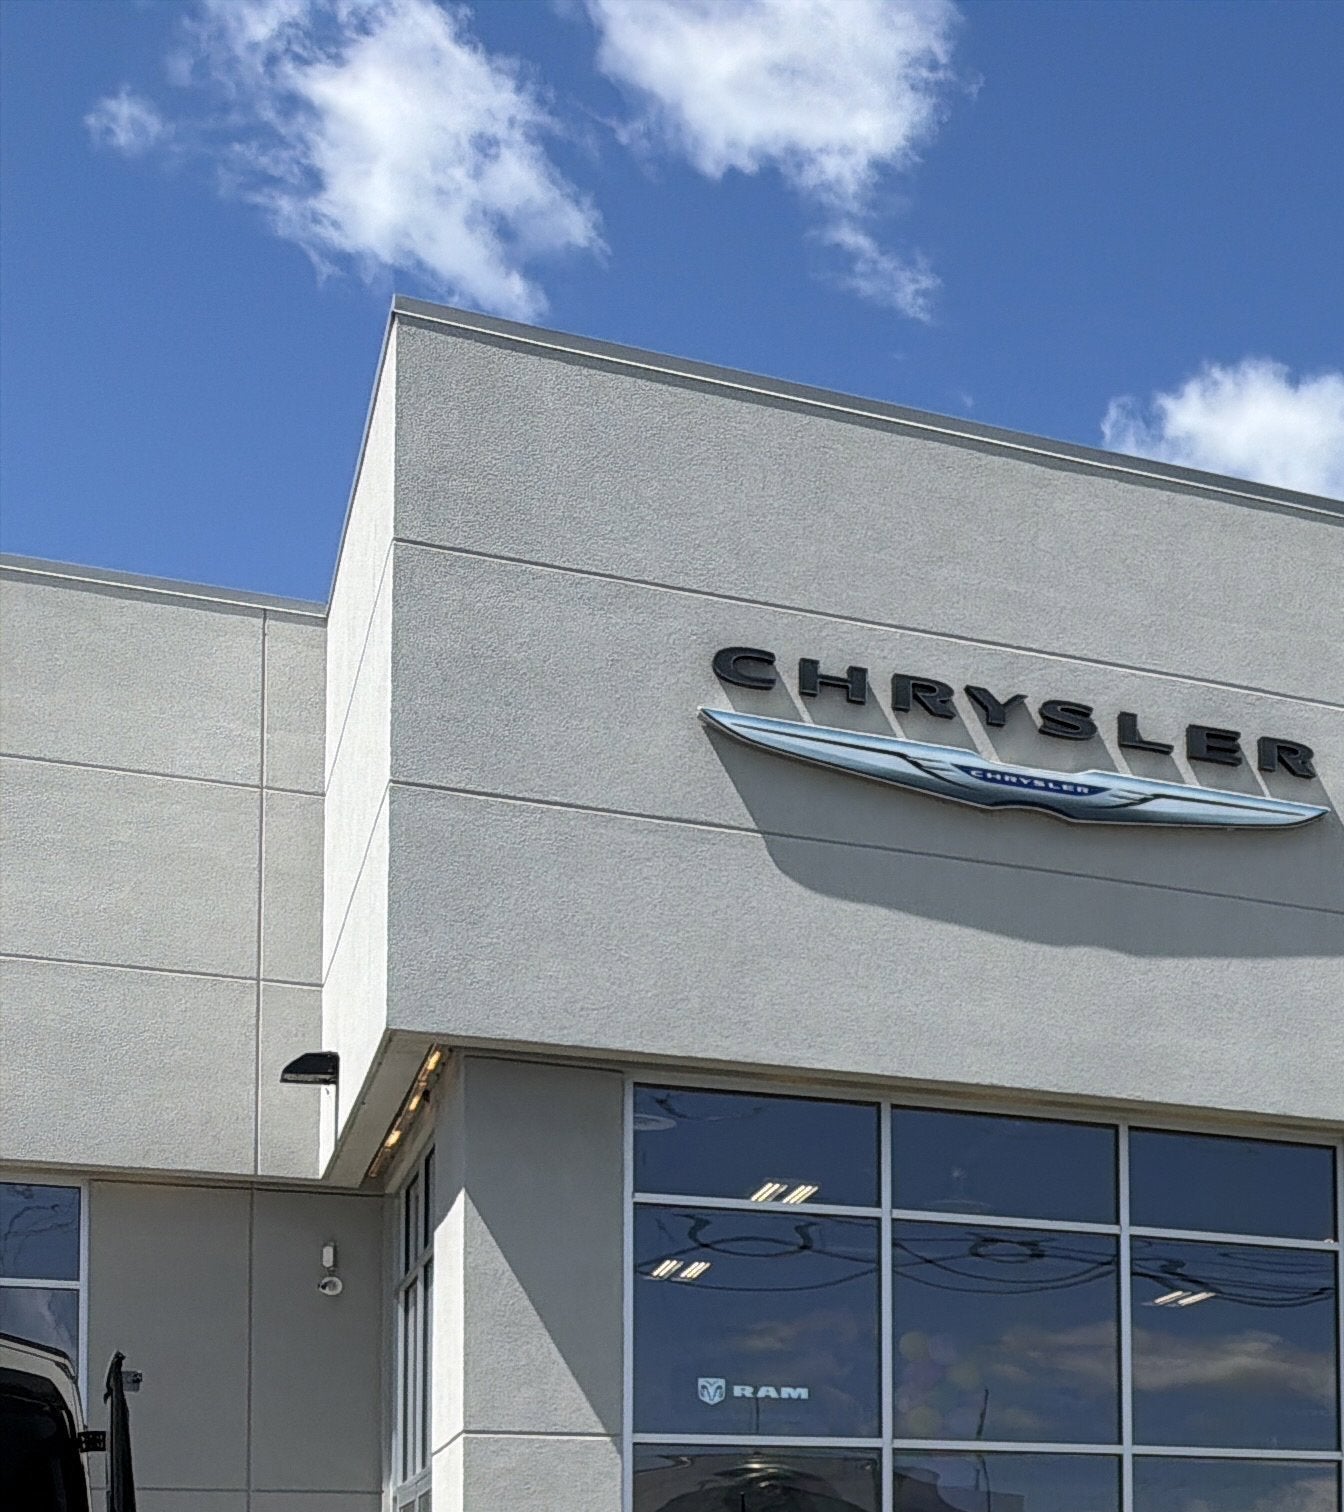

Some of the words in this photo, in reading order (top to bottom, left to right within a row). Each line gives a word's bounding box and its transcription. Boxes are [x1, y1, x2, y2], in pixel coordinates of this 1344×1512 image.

[712, 647, 1315, 778] CHRYSLER
[970, 770, 1089, 794] CHRYSLER
[733, 1385, 809, 1400] RAM
